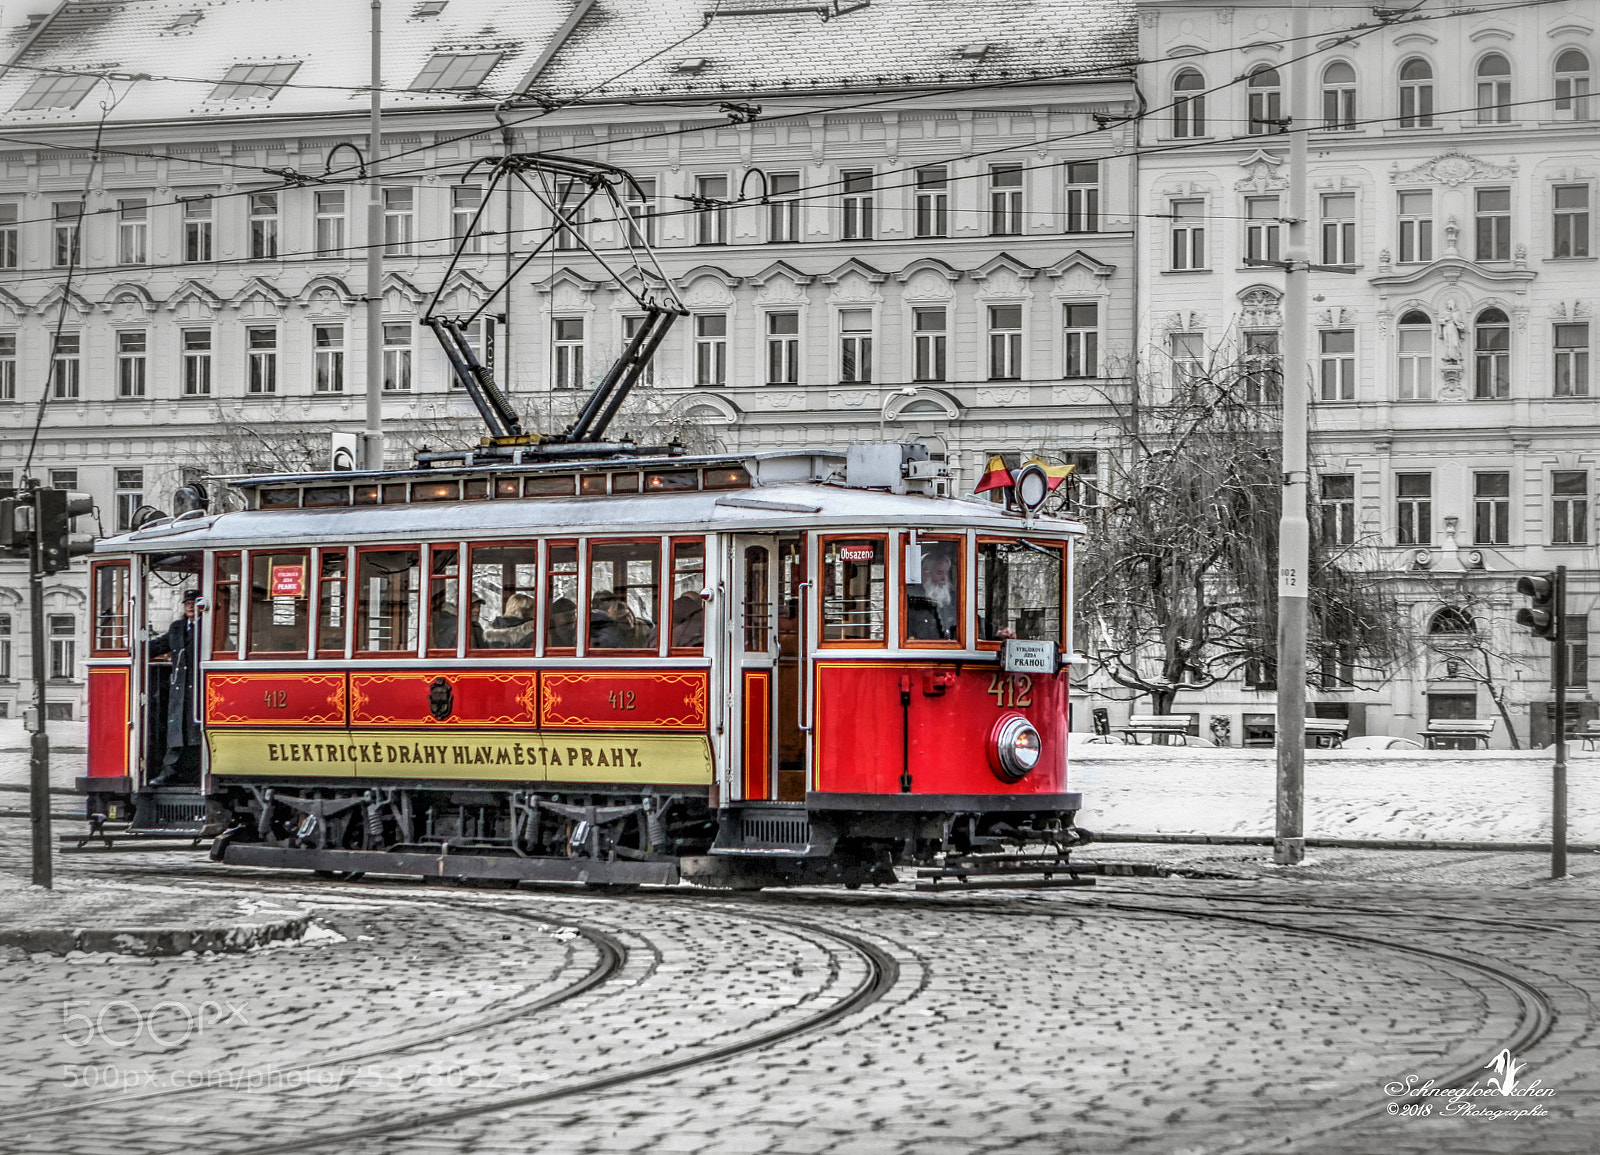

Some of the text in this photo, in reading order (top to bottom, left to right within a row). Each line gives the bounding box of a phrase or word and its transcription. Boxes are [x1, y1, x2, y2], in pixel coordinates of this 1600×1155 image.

[841, 548, 874, 560] Obsazeno
[1014, 658, 1045, 667] PRAHOU
[264, 689, 288, 709] 412
[608, 690, 636, 710] 412
[987, 673, 1032, 708] 412
[566, 747, 642, 768] PRAHY.
